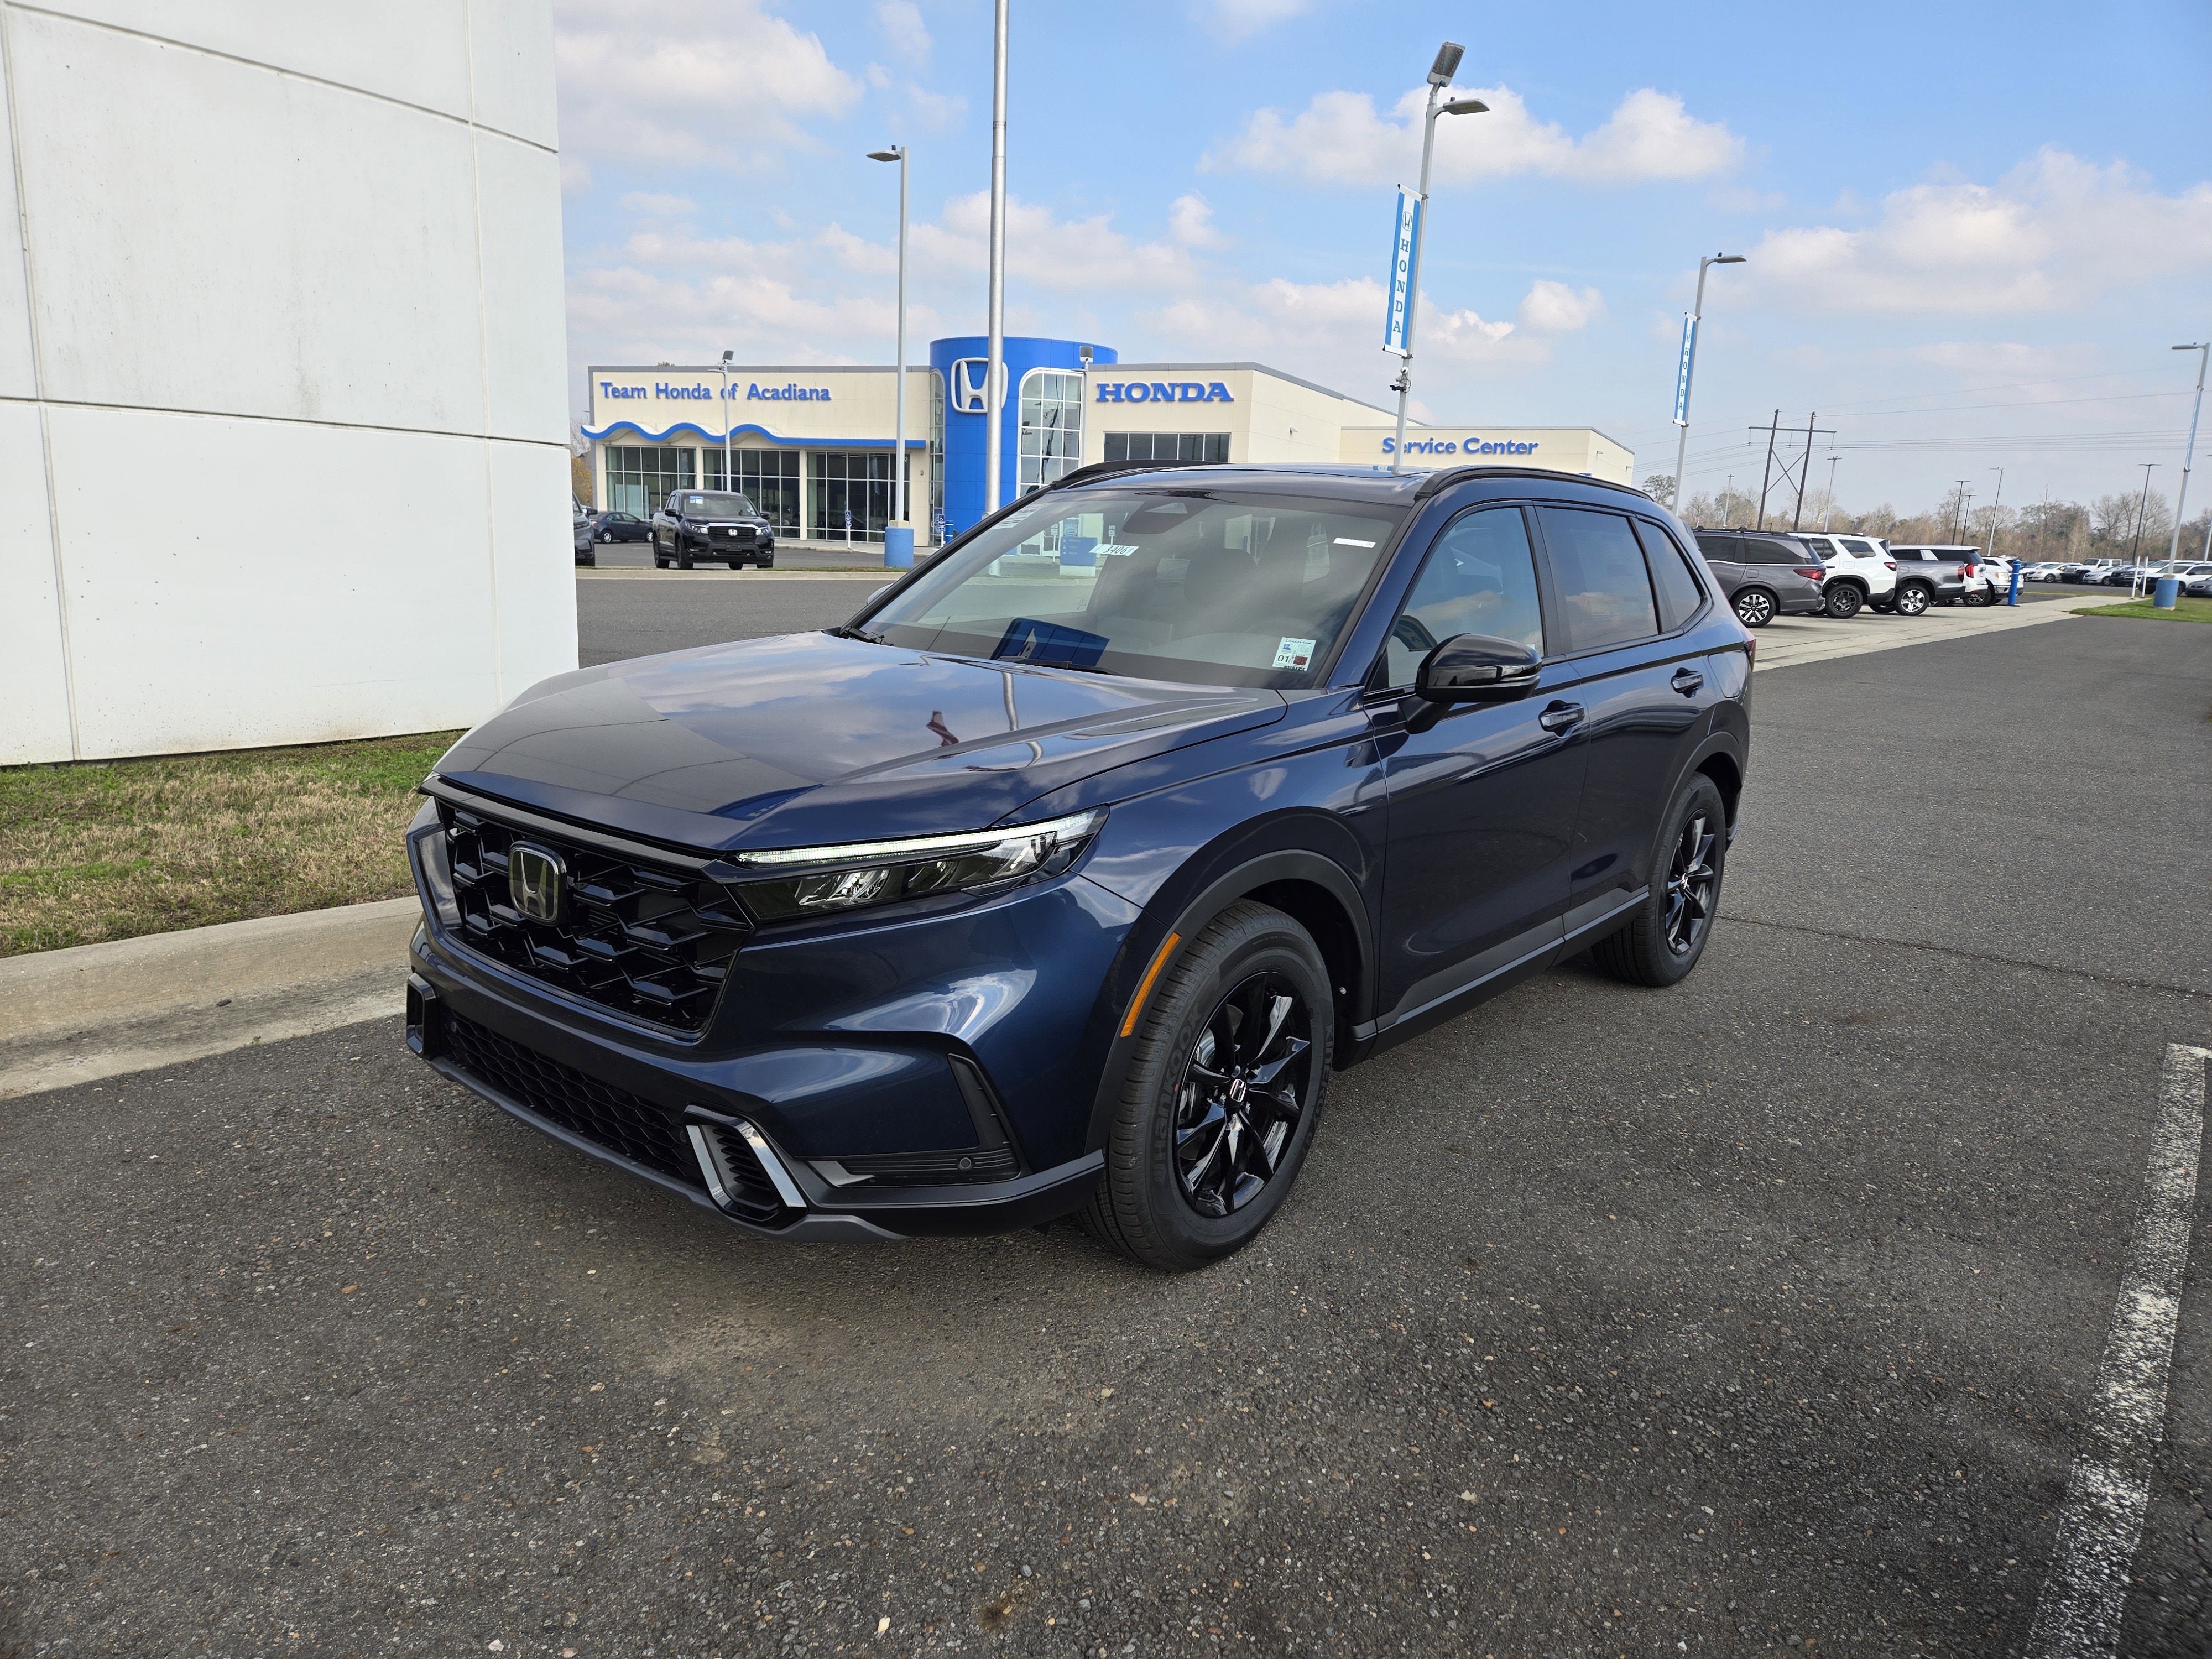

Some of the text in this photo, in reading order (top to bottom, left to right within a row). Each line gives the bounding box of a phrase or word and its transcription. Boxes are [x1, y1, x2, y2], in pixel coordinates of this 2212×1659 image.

[1392, 238, 1410, 333] HONDA
[1678, 347, 1689, 410] HONDA
[599, 382, 831, 401] Team Honda of Acadiana
[1096, 382, 1234, 402] HONDA
[1463, 437, 1539, 455] Center
[1103, 545, 1130, 554] 3406
